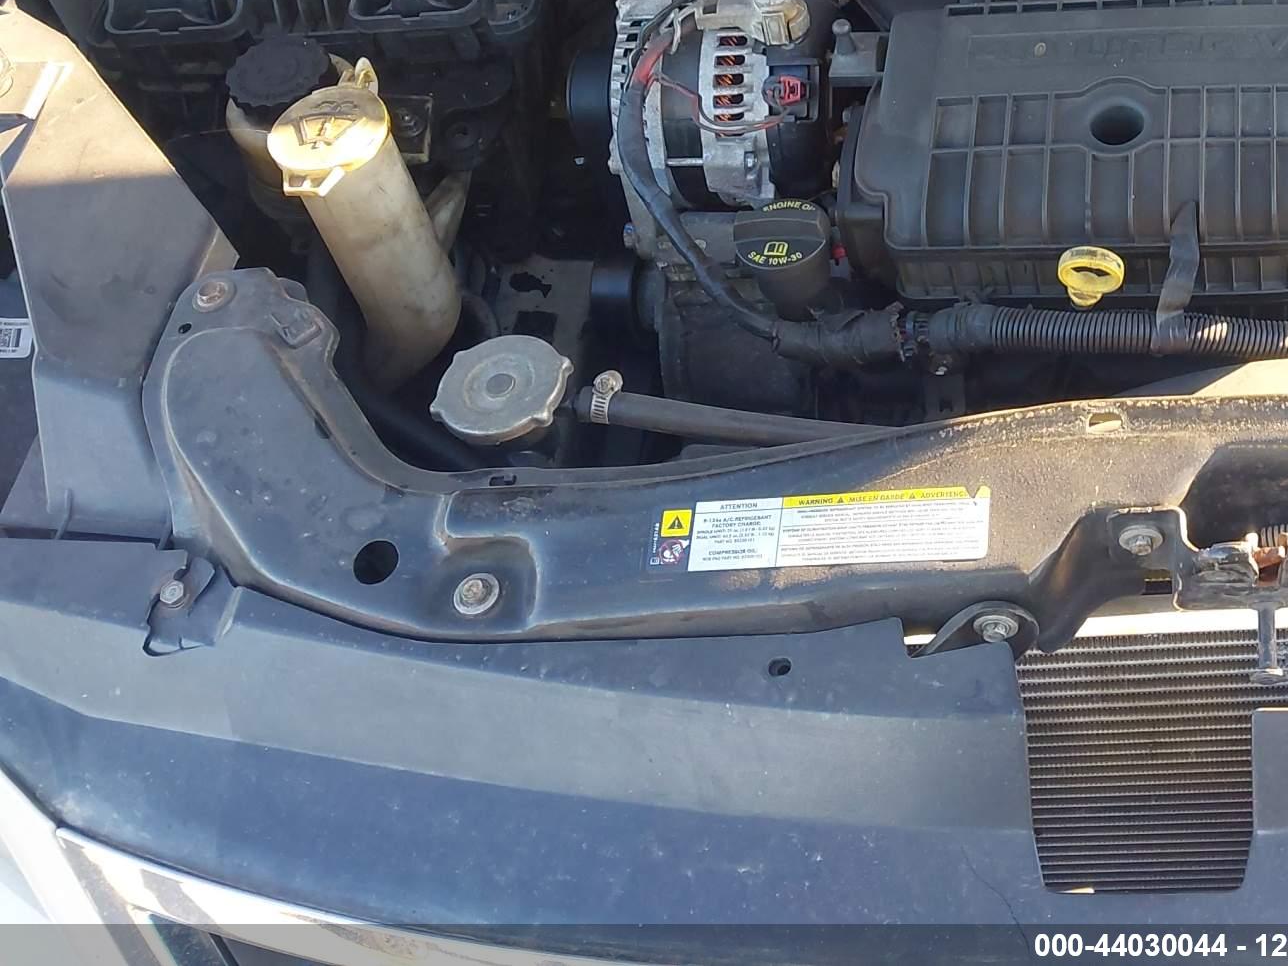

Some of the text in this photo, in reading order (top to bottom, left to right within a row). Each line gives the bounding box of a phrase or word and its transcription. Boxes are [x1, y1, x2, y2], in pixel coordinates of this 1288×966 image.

[747, 251, 803, 265] SAE 10W-30
[799, 497, 833, 505] WARNING
[720, 502, 757, 510] ATTENTION
